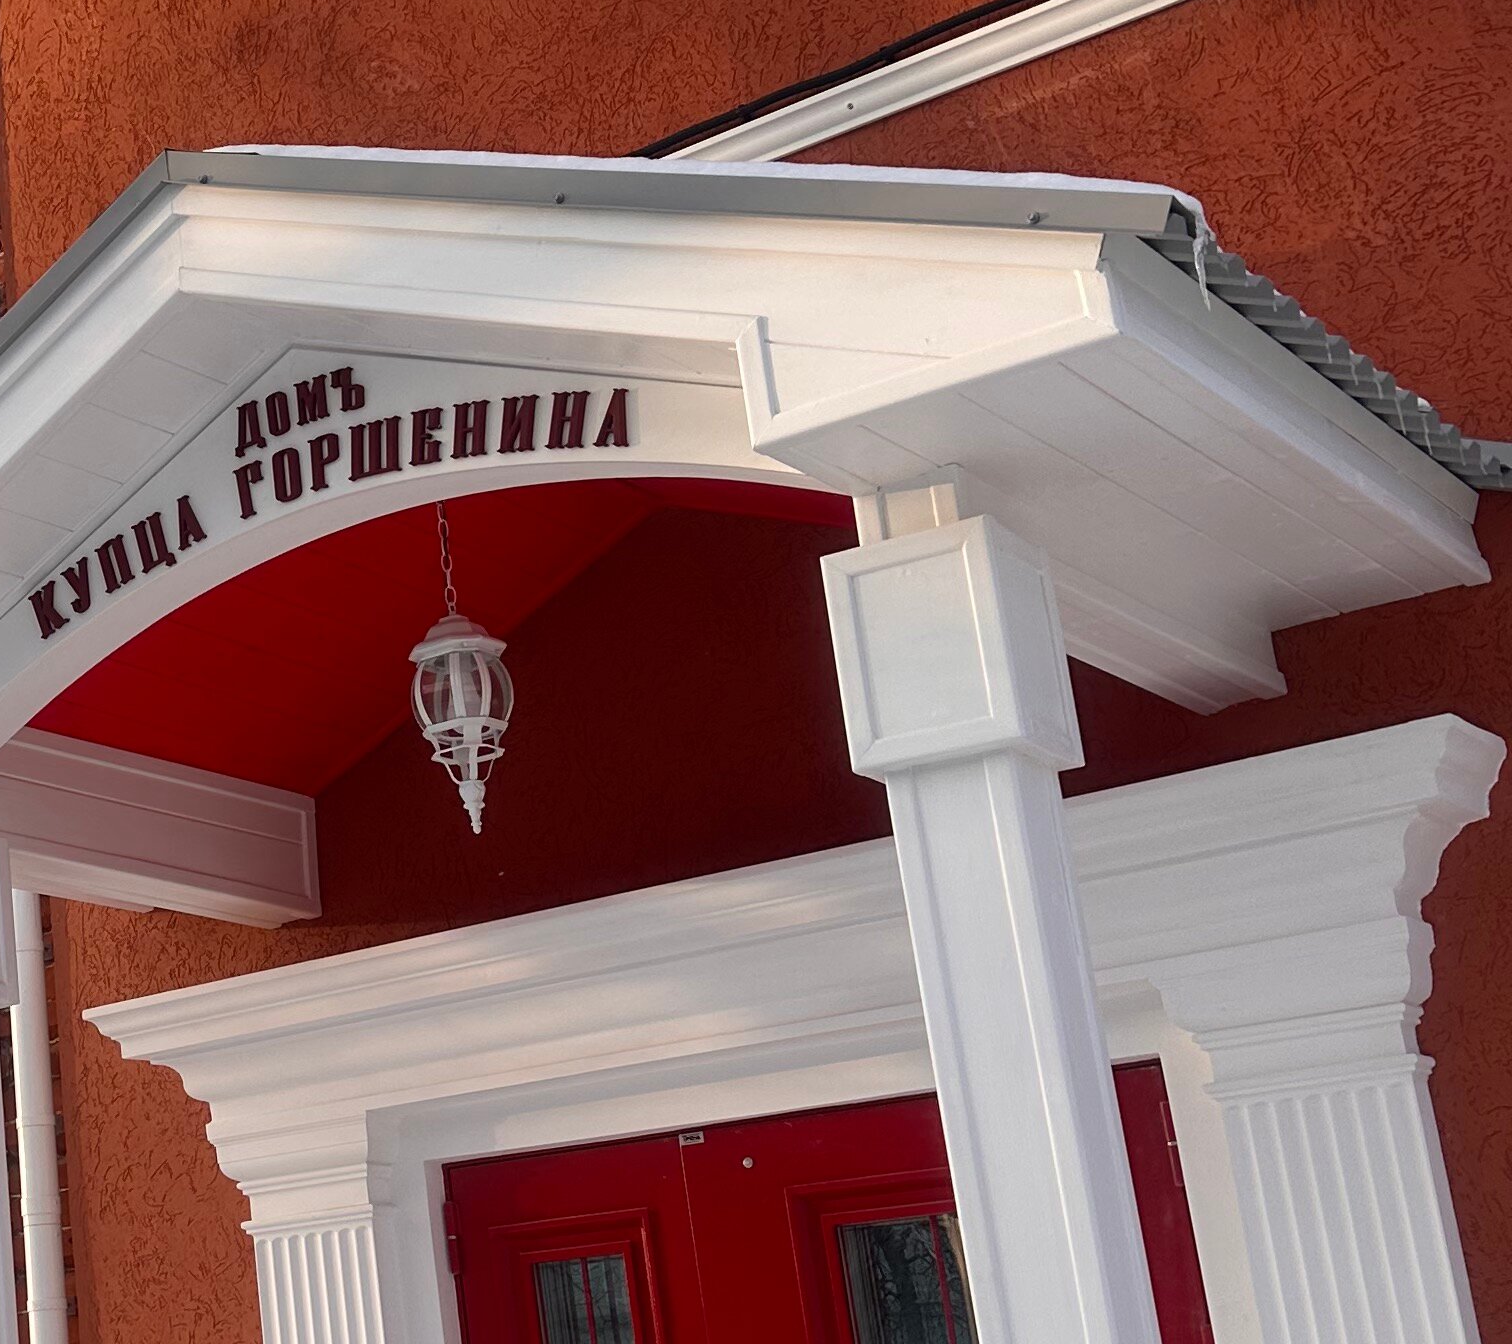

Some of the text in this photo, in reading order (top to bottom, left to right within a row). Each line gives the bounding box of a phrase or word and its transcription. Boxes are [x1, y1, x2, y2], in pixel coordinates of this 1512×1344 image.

[234, 366, 367, 457] ДОМЪ
[27, 387, 630, 641] КУПЦА ГОРШЕНИНА
